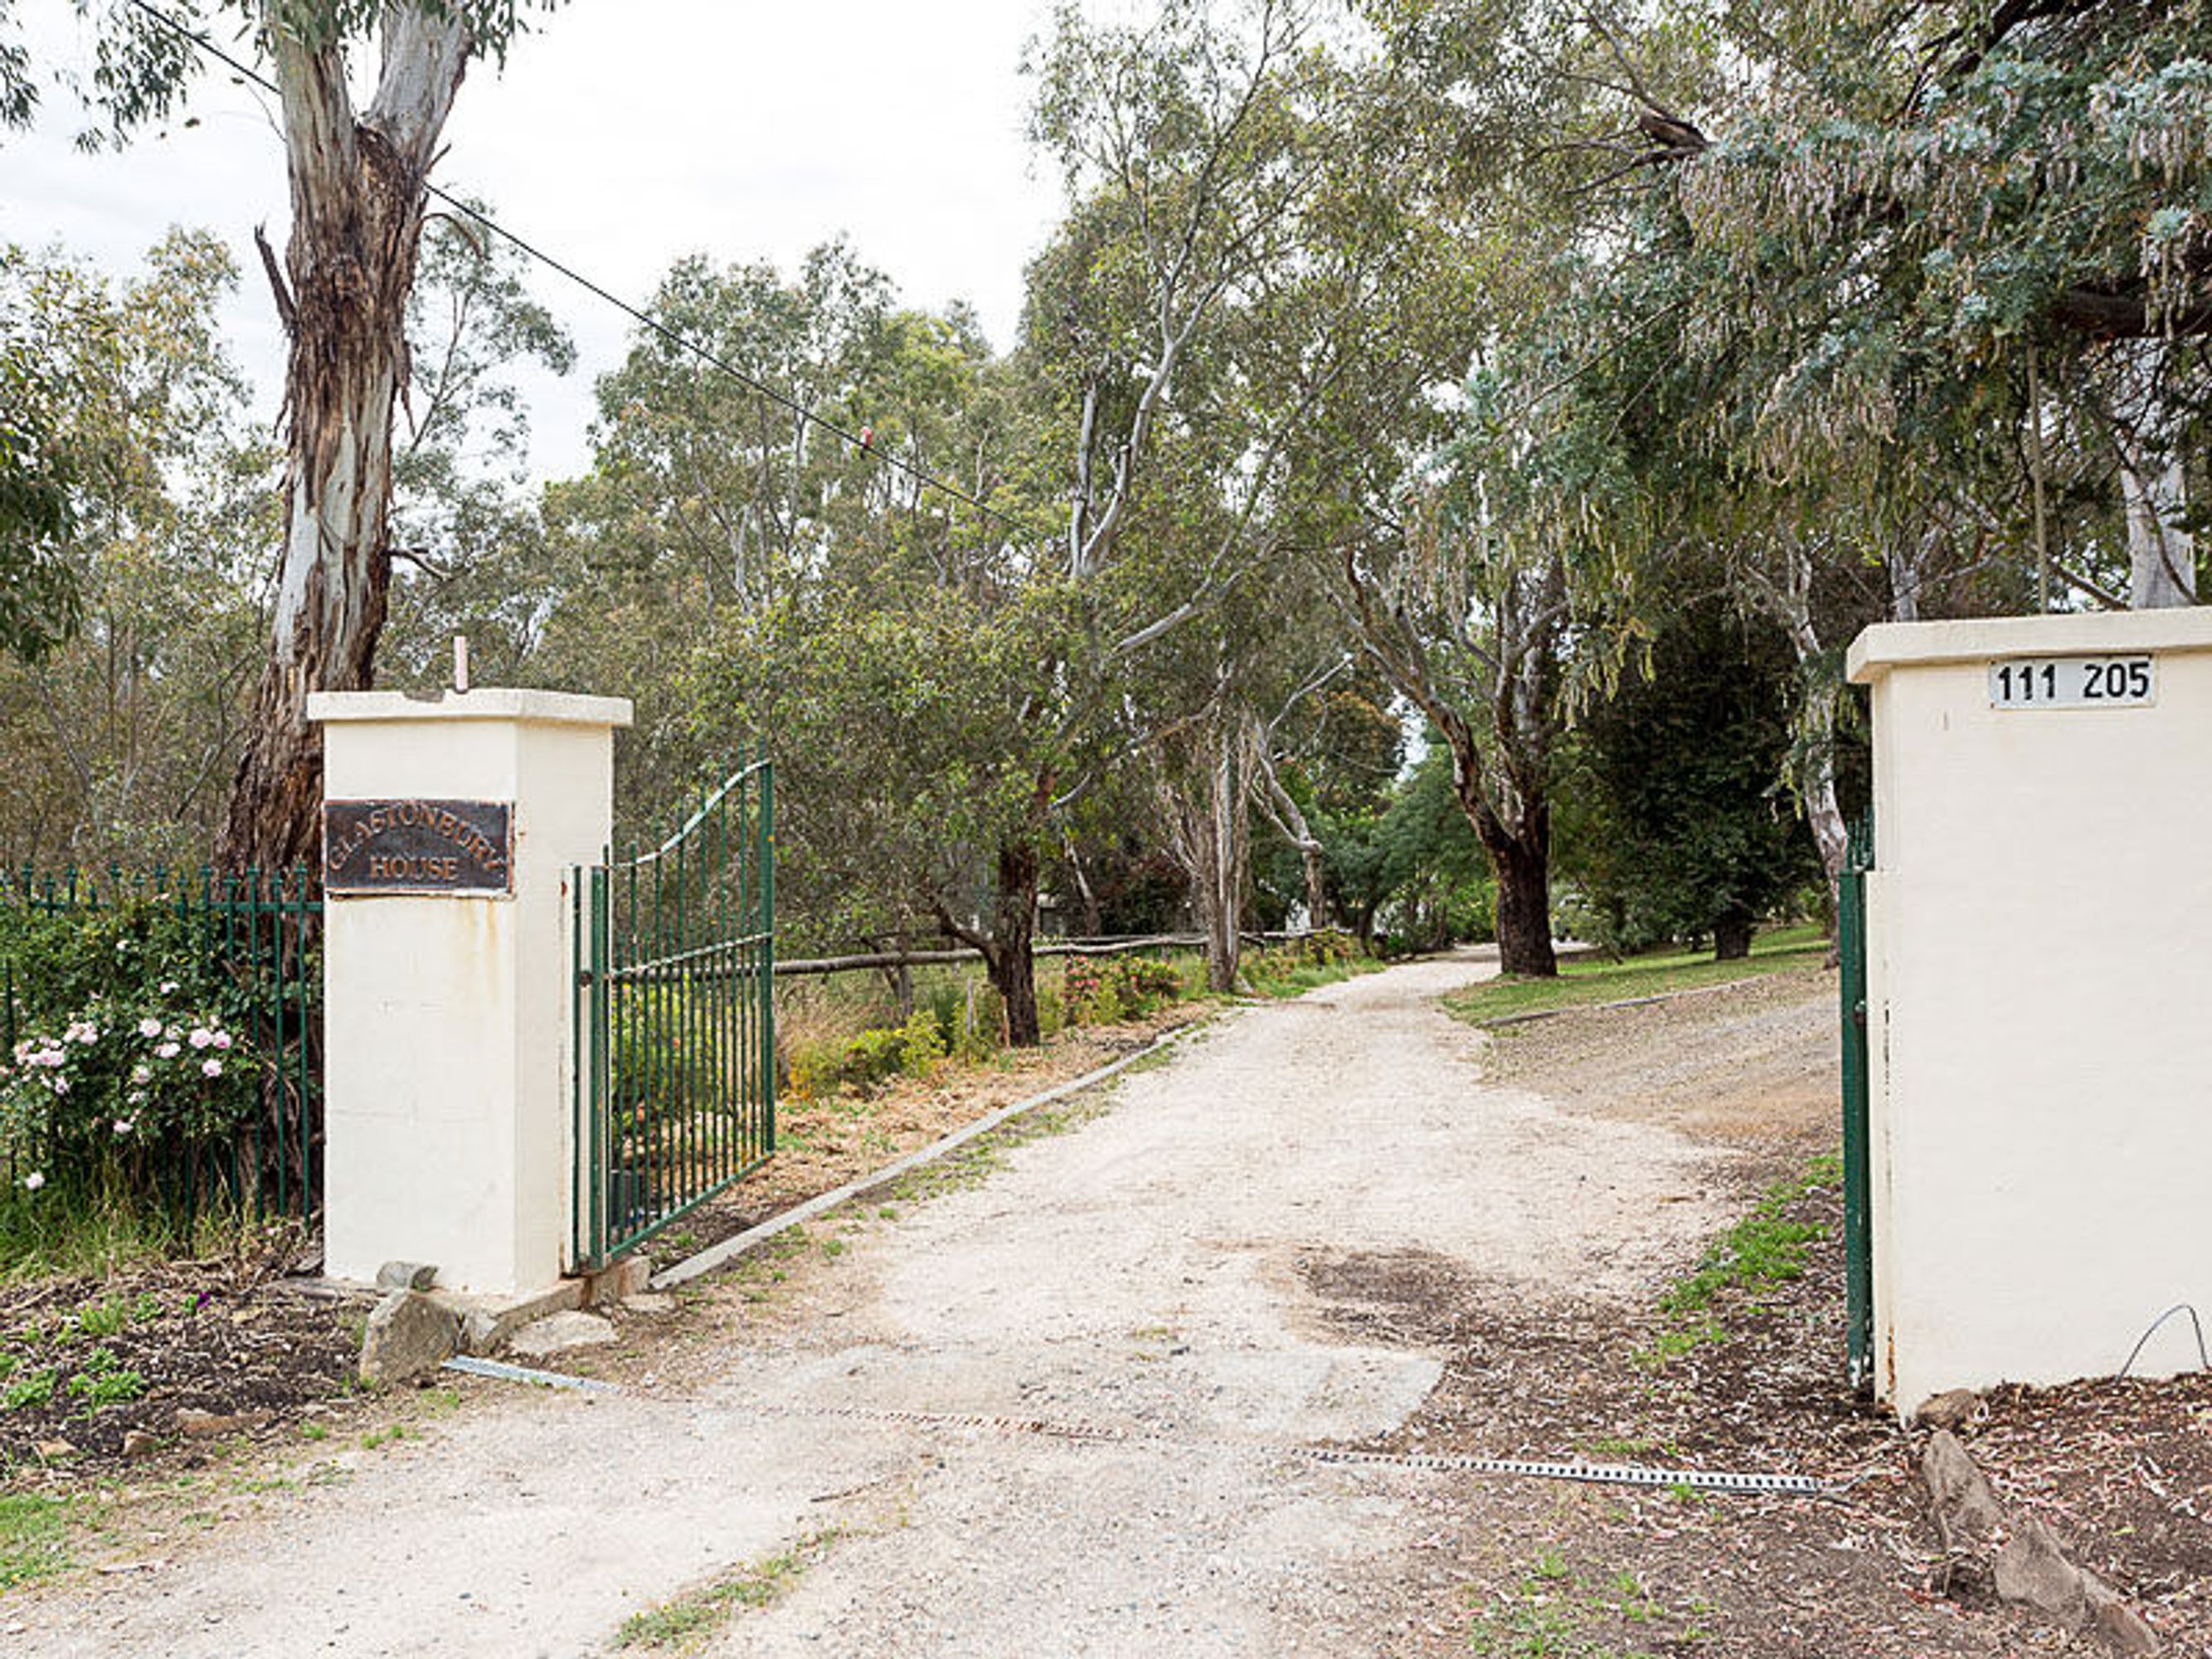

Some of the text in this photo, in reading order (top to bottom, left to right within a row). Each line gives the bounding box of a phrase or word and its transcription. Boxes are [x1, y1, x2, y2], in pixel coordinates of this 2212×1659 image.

[1998, 662, 2149, 700] 111 205
[369, 855, 458, 880] HOUSE
